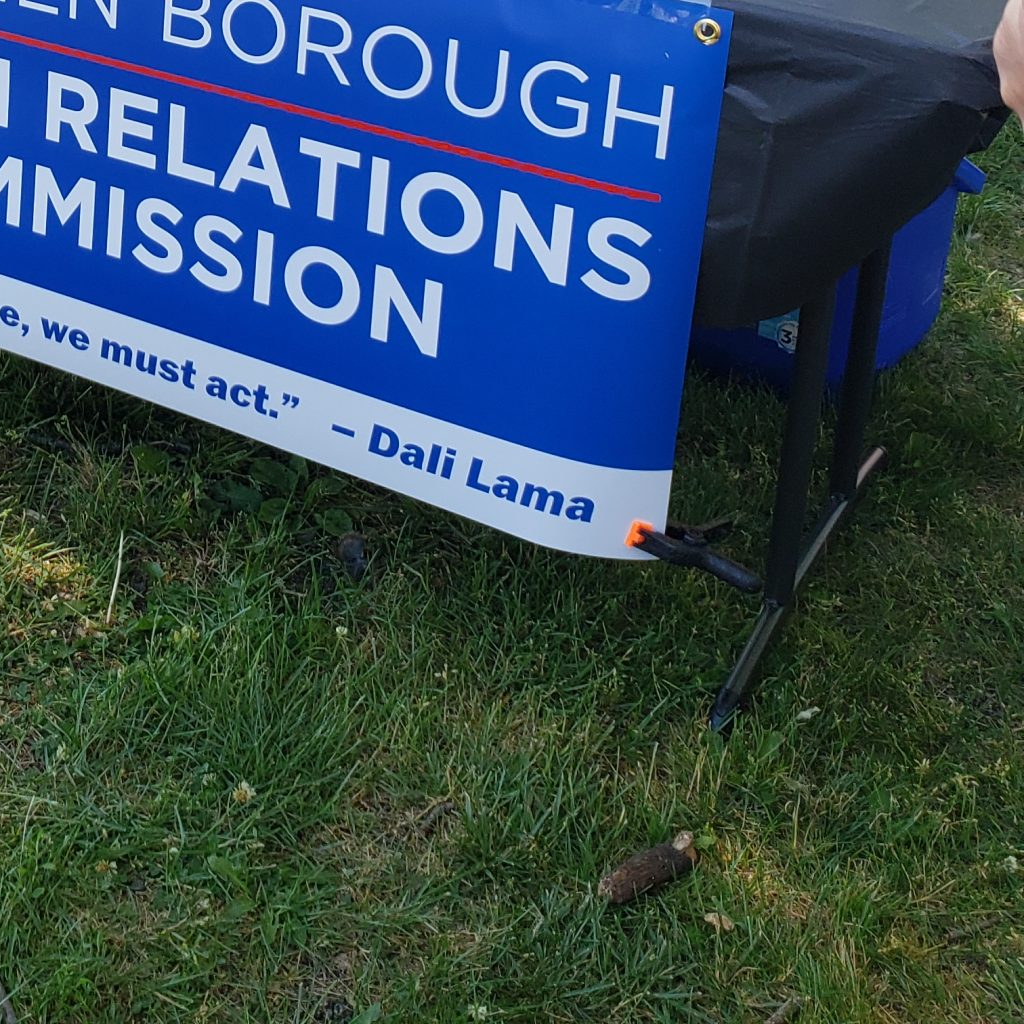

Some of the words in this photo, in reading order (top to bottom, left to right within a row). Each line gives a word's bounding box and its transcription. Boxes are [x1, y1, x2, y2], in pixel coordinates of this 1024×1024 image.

[45, 70, 652, 302] RELATIONS
[40, 316, 90, 351] we
[100, 337, 197, 390] must
[368, 423, 457, 480] Dali
[465, 456, 595, 523] Lama
[781, 328, 793, 344] 3
